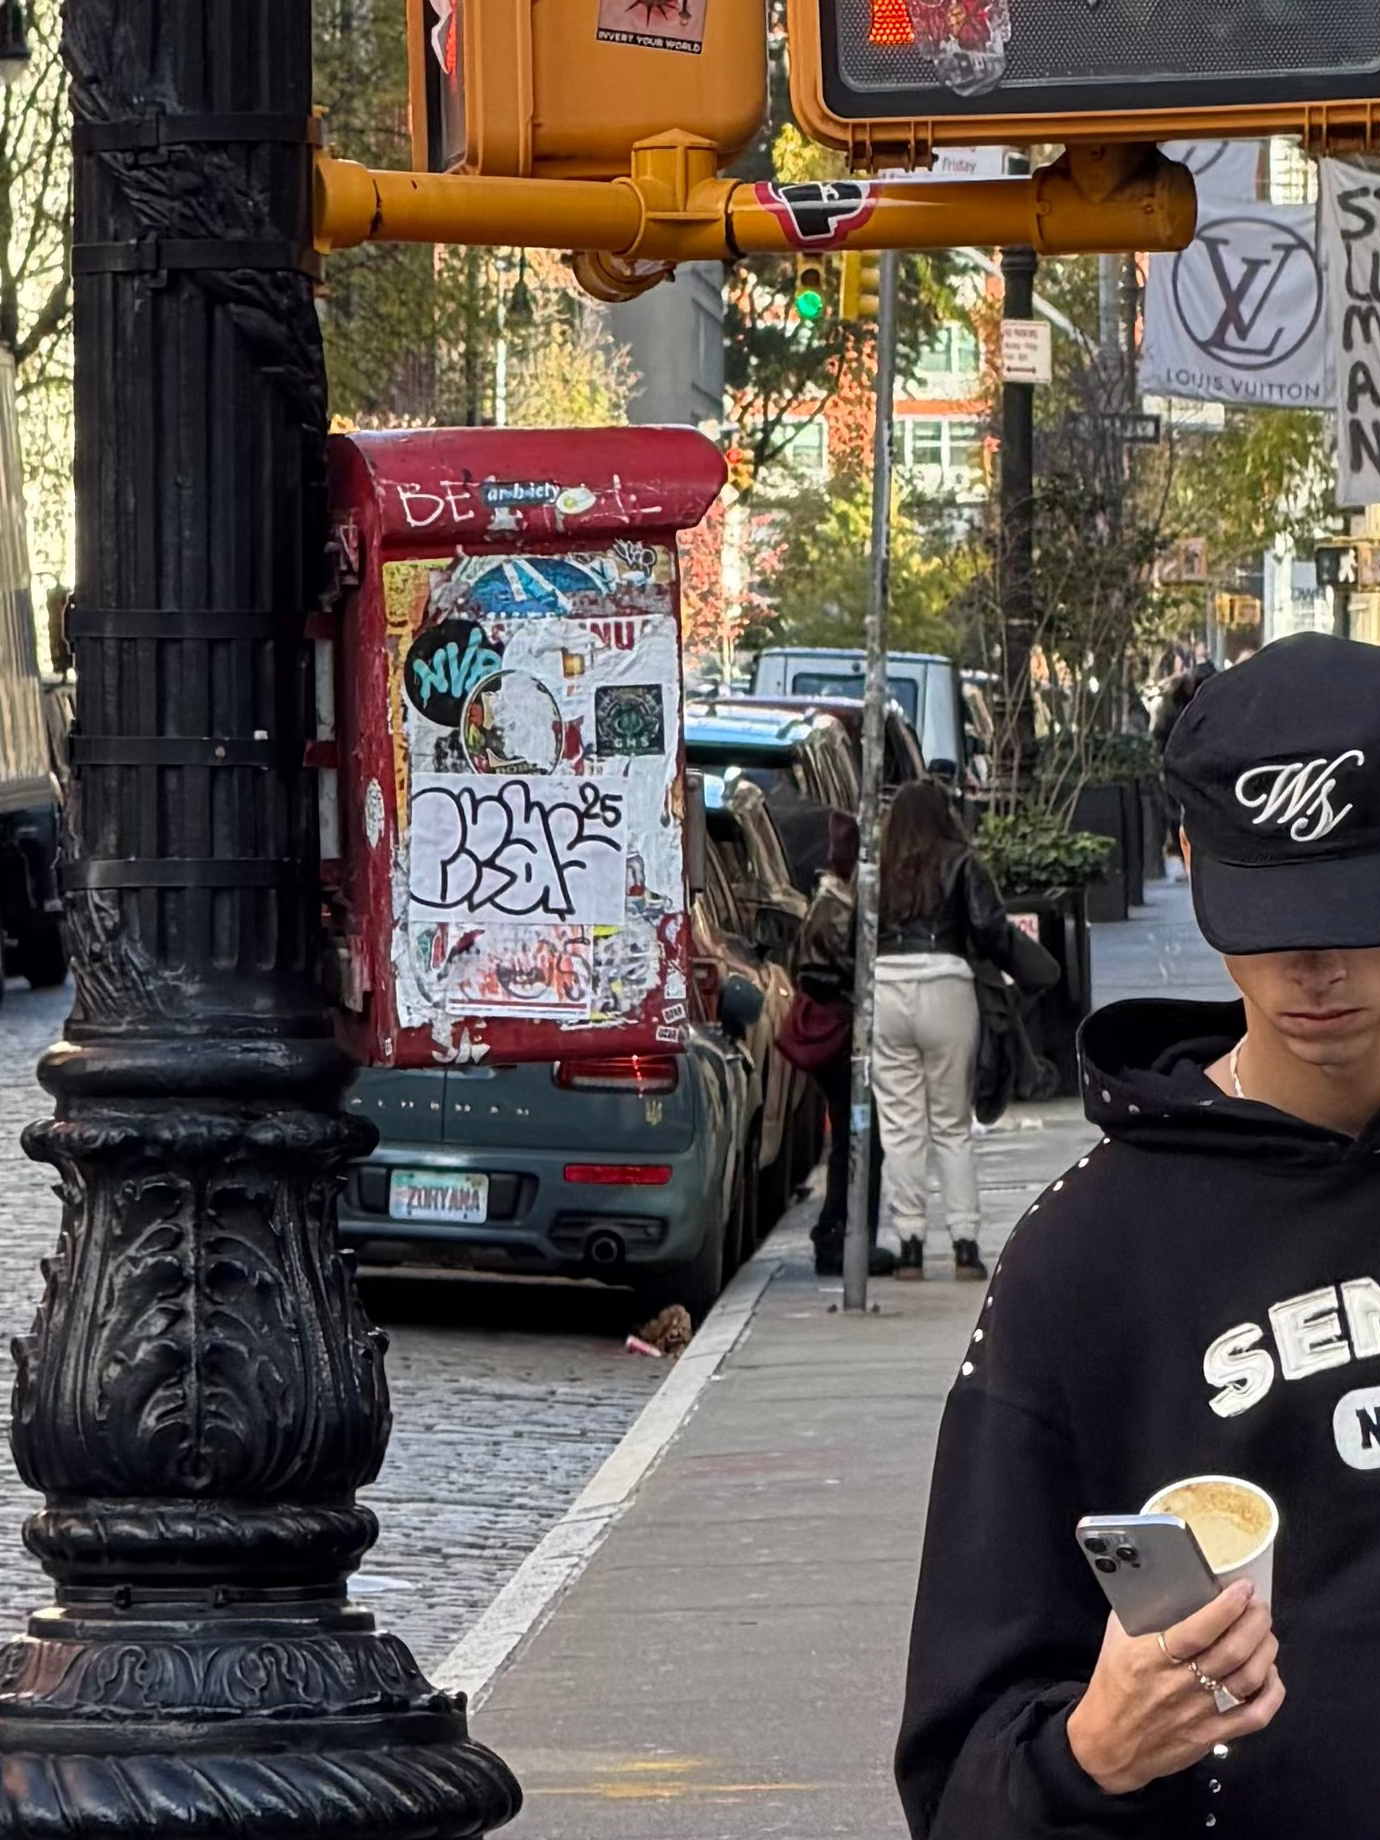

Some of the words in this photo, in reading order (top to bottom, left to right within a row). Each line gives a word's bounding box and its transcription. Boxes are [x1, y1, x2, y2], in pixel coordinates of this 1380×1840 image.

[636, 35, 664, 48] YOUR
[665, 40, 702, 54] WORLD
[1166, 366, 1225, 392] LOUIS
[1230, 374, 1321, 400] VUITTON
[579, 781, 624, 829] 25
